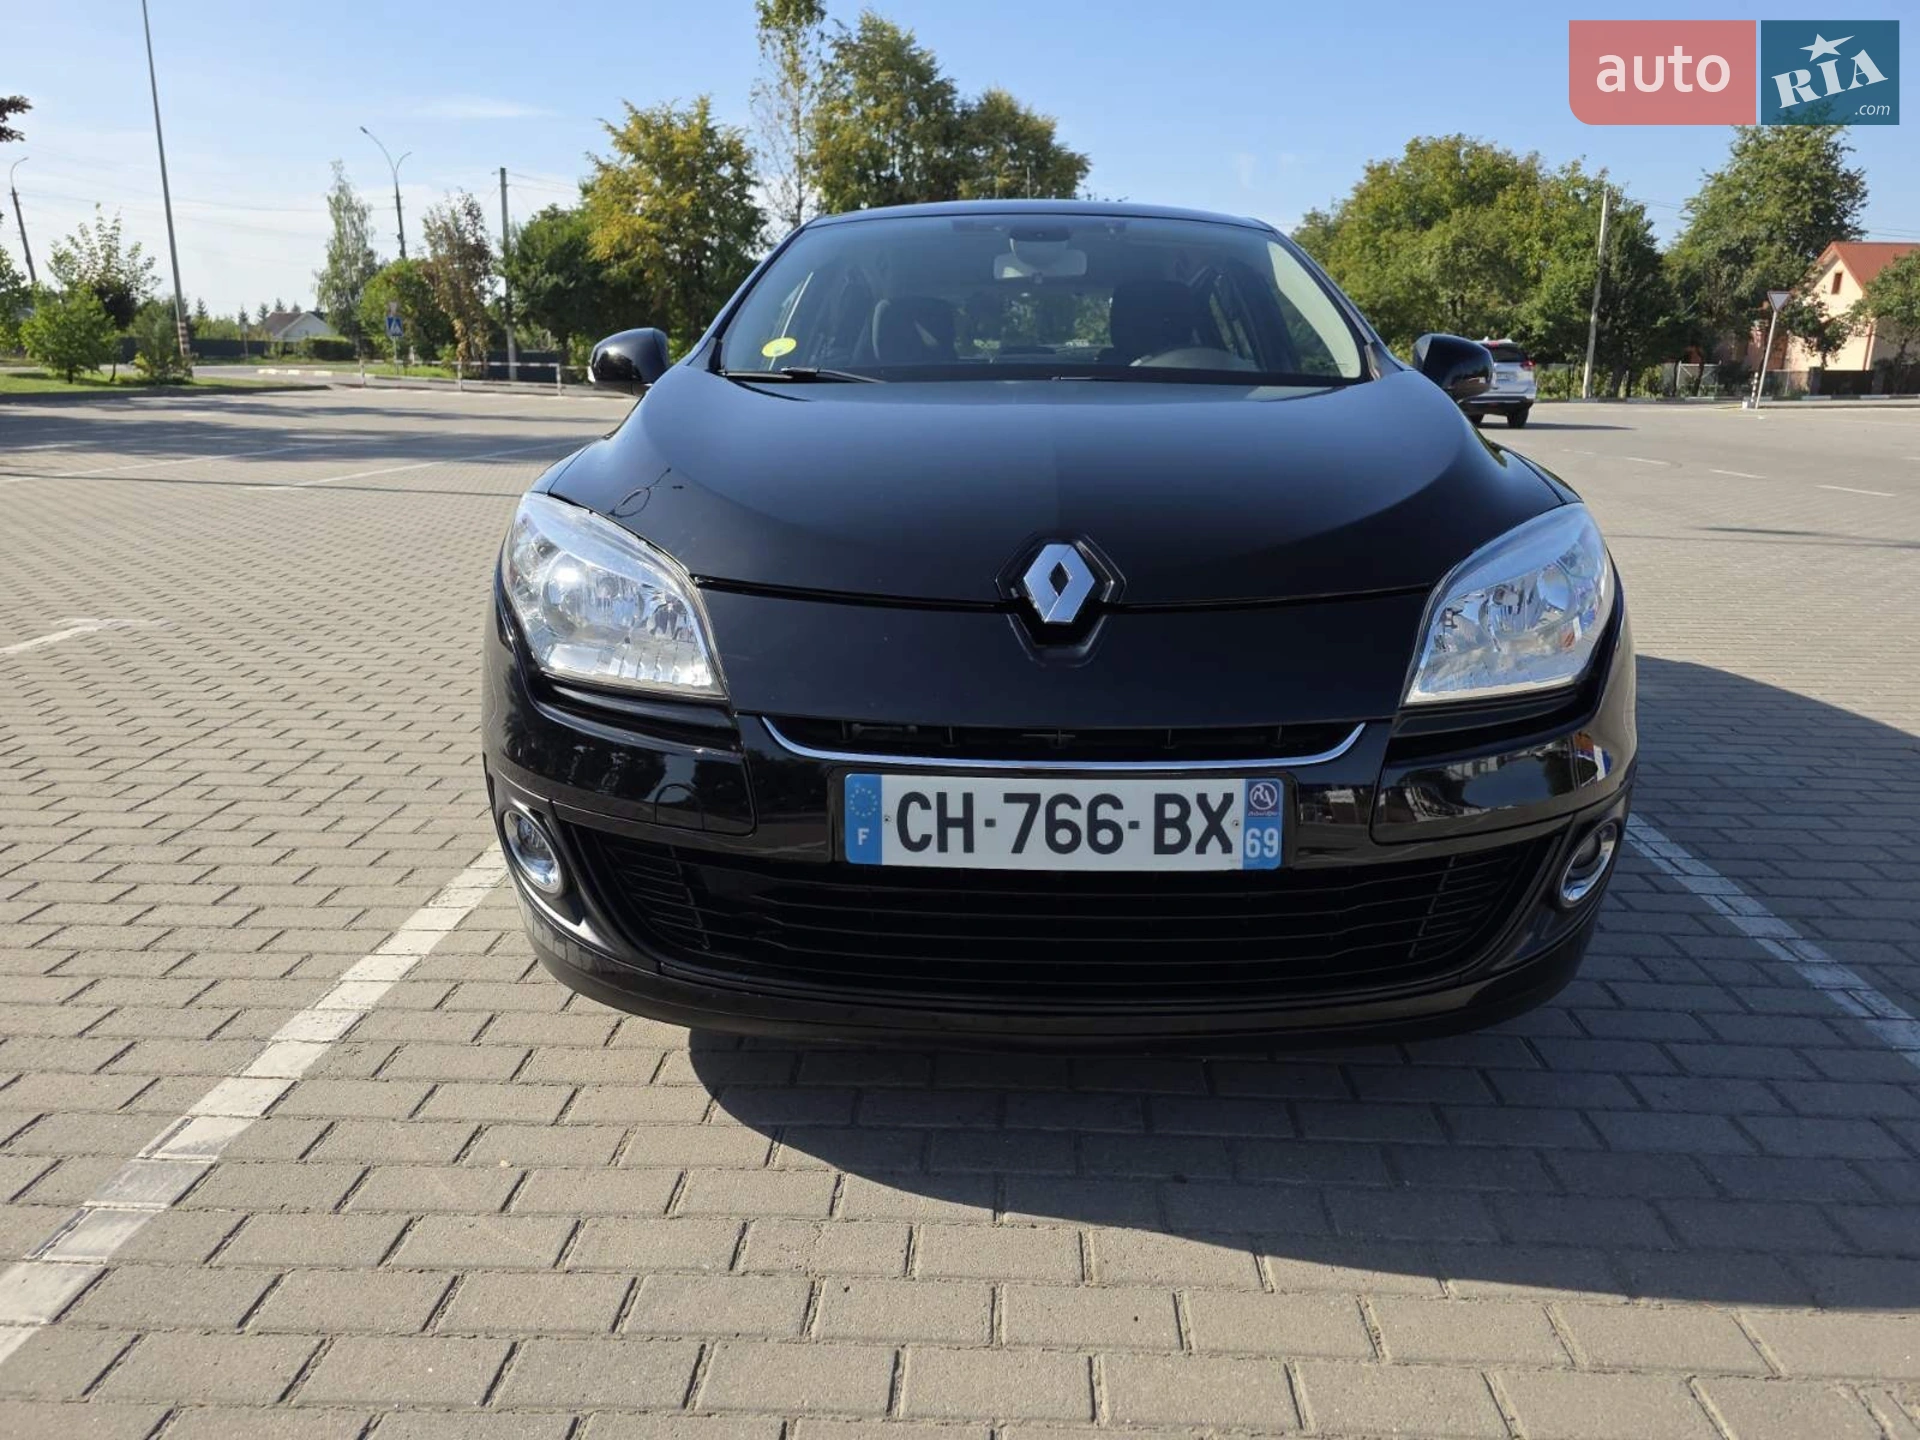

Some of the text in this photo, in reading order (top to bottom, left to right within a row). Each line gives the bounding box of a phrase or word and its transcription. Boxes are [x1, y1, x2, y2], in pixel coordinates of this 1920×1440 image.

[857, 828, 870, 846] F
[896, 791, 1234, 855] CH-766-BX
[1246, 828, 1279, 858] 69
